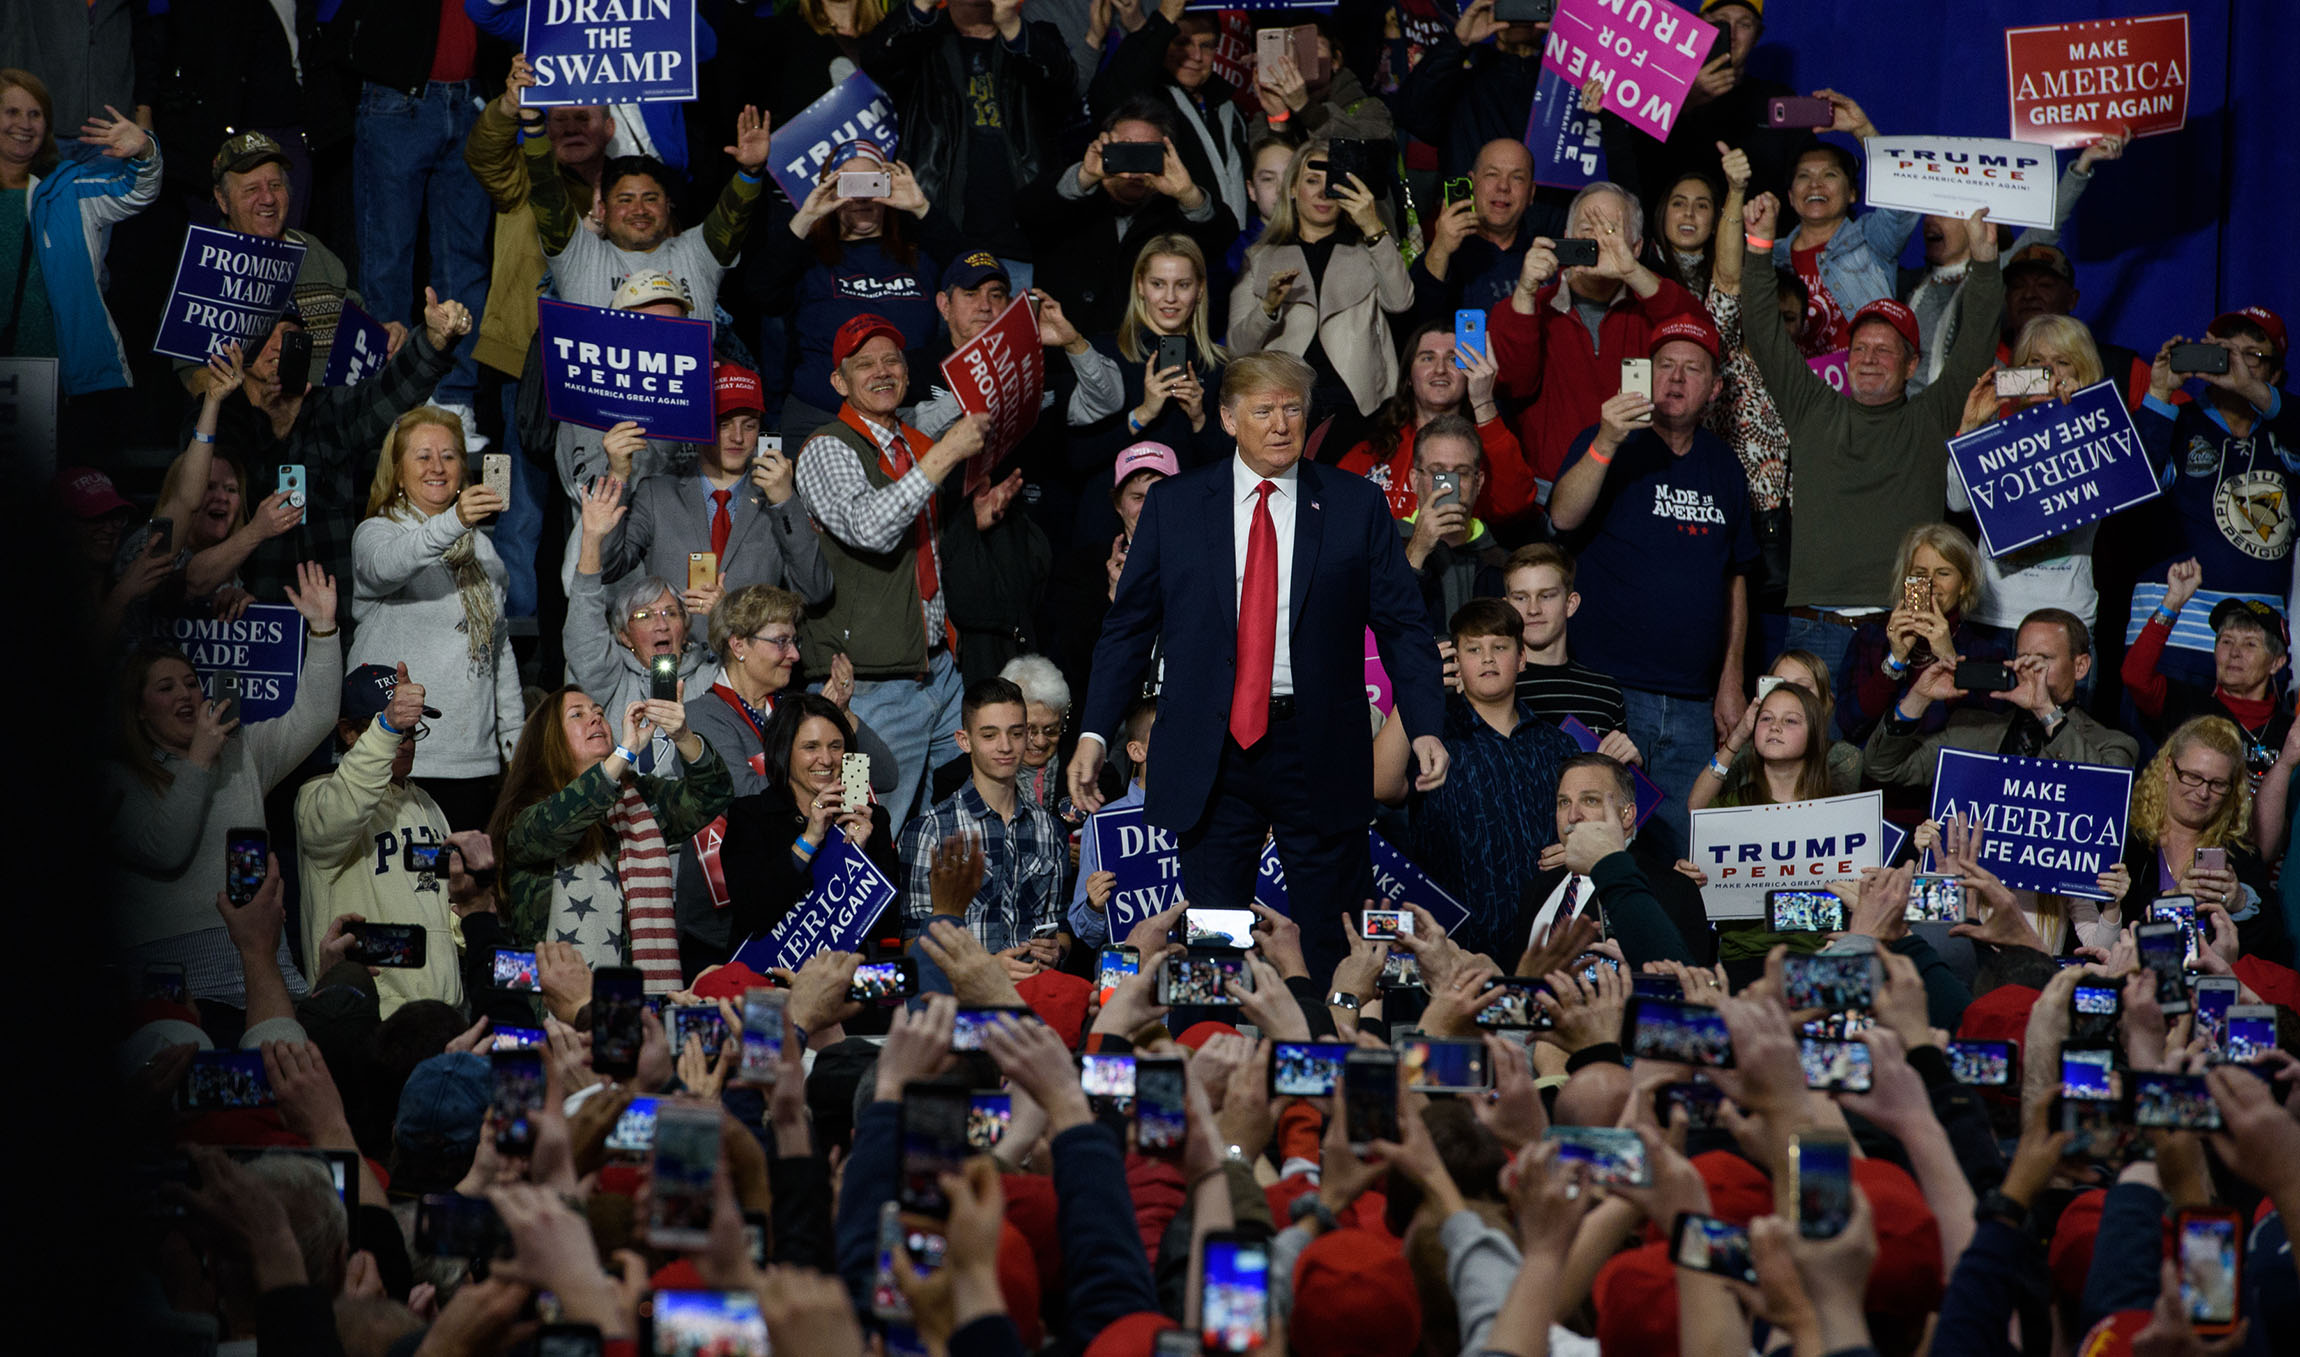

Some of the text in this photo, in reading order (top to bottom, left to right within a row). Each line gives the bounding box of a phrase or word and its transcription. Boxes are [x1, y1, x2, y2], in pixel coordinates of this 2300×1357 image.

[544, 0, 671, 26] DRAIN
[584, 27, 632, 49] THE
[1598, 25, 1648, 69] FOR
[2069, 39, 2129, 61] MAKE
[534, 51, 682, 87] SWAMP
[1546, 31, 1673, 132] WOMEN
[2016, 59, 2184, 101] AMERICA
[2029, 94, 2174, 126] GREAT AGAIN
[1883, 149, 2038, 168] TRUMP
[1899, 161, 2025, 181] PENCE
[1893, 172, 1919, 180] MAKE
[1921, 173, 1962, 184] AMERICA
[1965, 179, 1994, 187] GREAT
[198, 244, 295, 284] PROMISES
[219, 274, 276, 306] MADE
[553, 336, 697, 376] TRUMP
[564, 382, 690, 407] MAKE AMERICA GREAT AGAIN!
[567, 364, 684, 394] PENCE
[2055, 408, 2111, 444] SAFE
[1978, 428, 2051, 475] AGAIN
[1971, 427, 2134, 510] AMERICA
[1655, 484, 1700, 506] MADE
[2039, 480, 2100, 516] MAKE
[1652, 500, 1726, 525] AMERICA
[374, 673, 400, 689] TRU
[2003, 778, 2067, 802] MAKE
[1936, 797, 2120, 847] AMERICA
[1708, 833, 1866, 864] TRUMP
[1978, 840, 2101, 874] FE AGAIN
[1722, 860, 1852, 878] PENCE
[1744, 881, 1787, 889] AMERICA
[764, 857, 866, 975] MERICA
[829, 871, 879, 944] AGAIN
[1115, 882, 1185, 925] SWA
